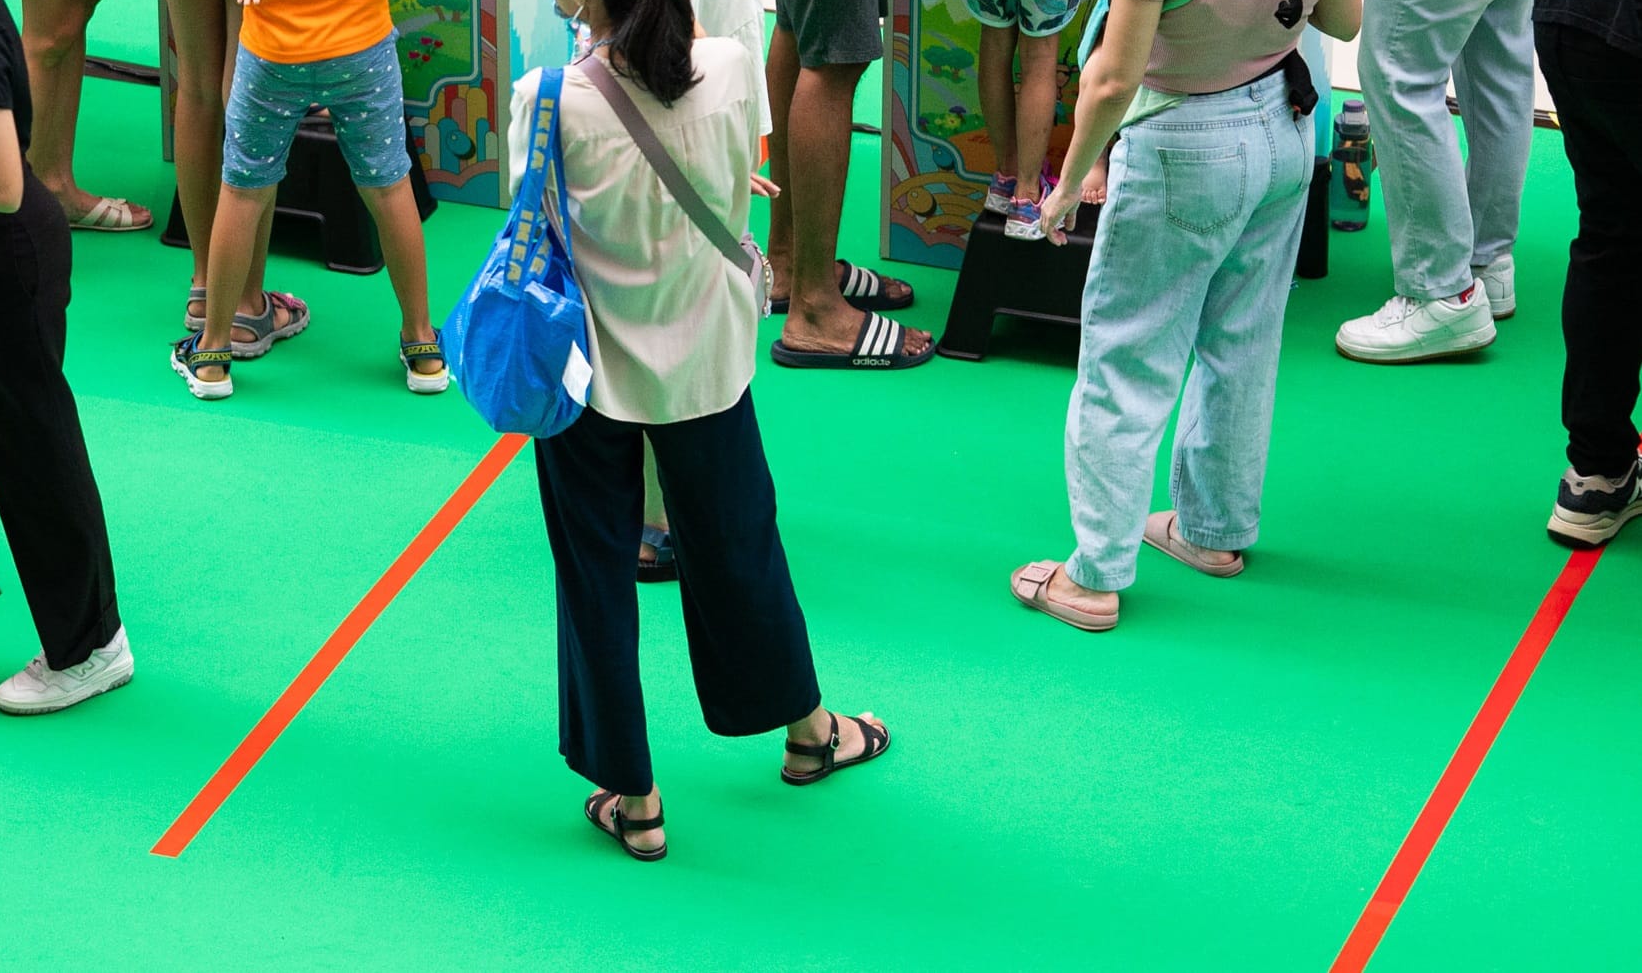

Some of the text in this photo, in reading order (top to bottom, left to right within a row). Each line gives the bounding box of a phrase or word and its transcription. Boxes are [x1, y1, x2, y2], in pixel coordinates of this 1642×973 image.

[531, 98, 555, 170] IKEA
[507, 210, 534, 281] IKEA
[853, 357, 891, 367] adidas
